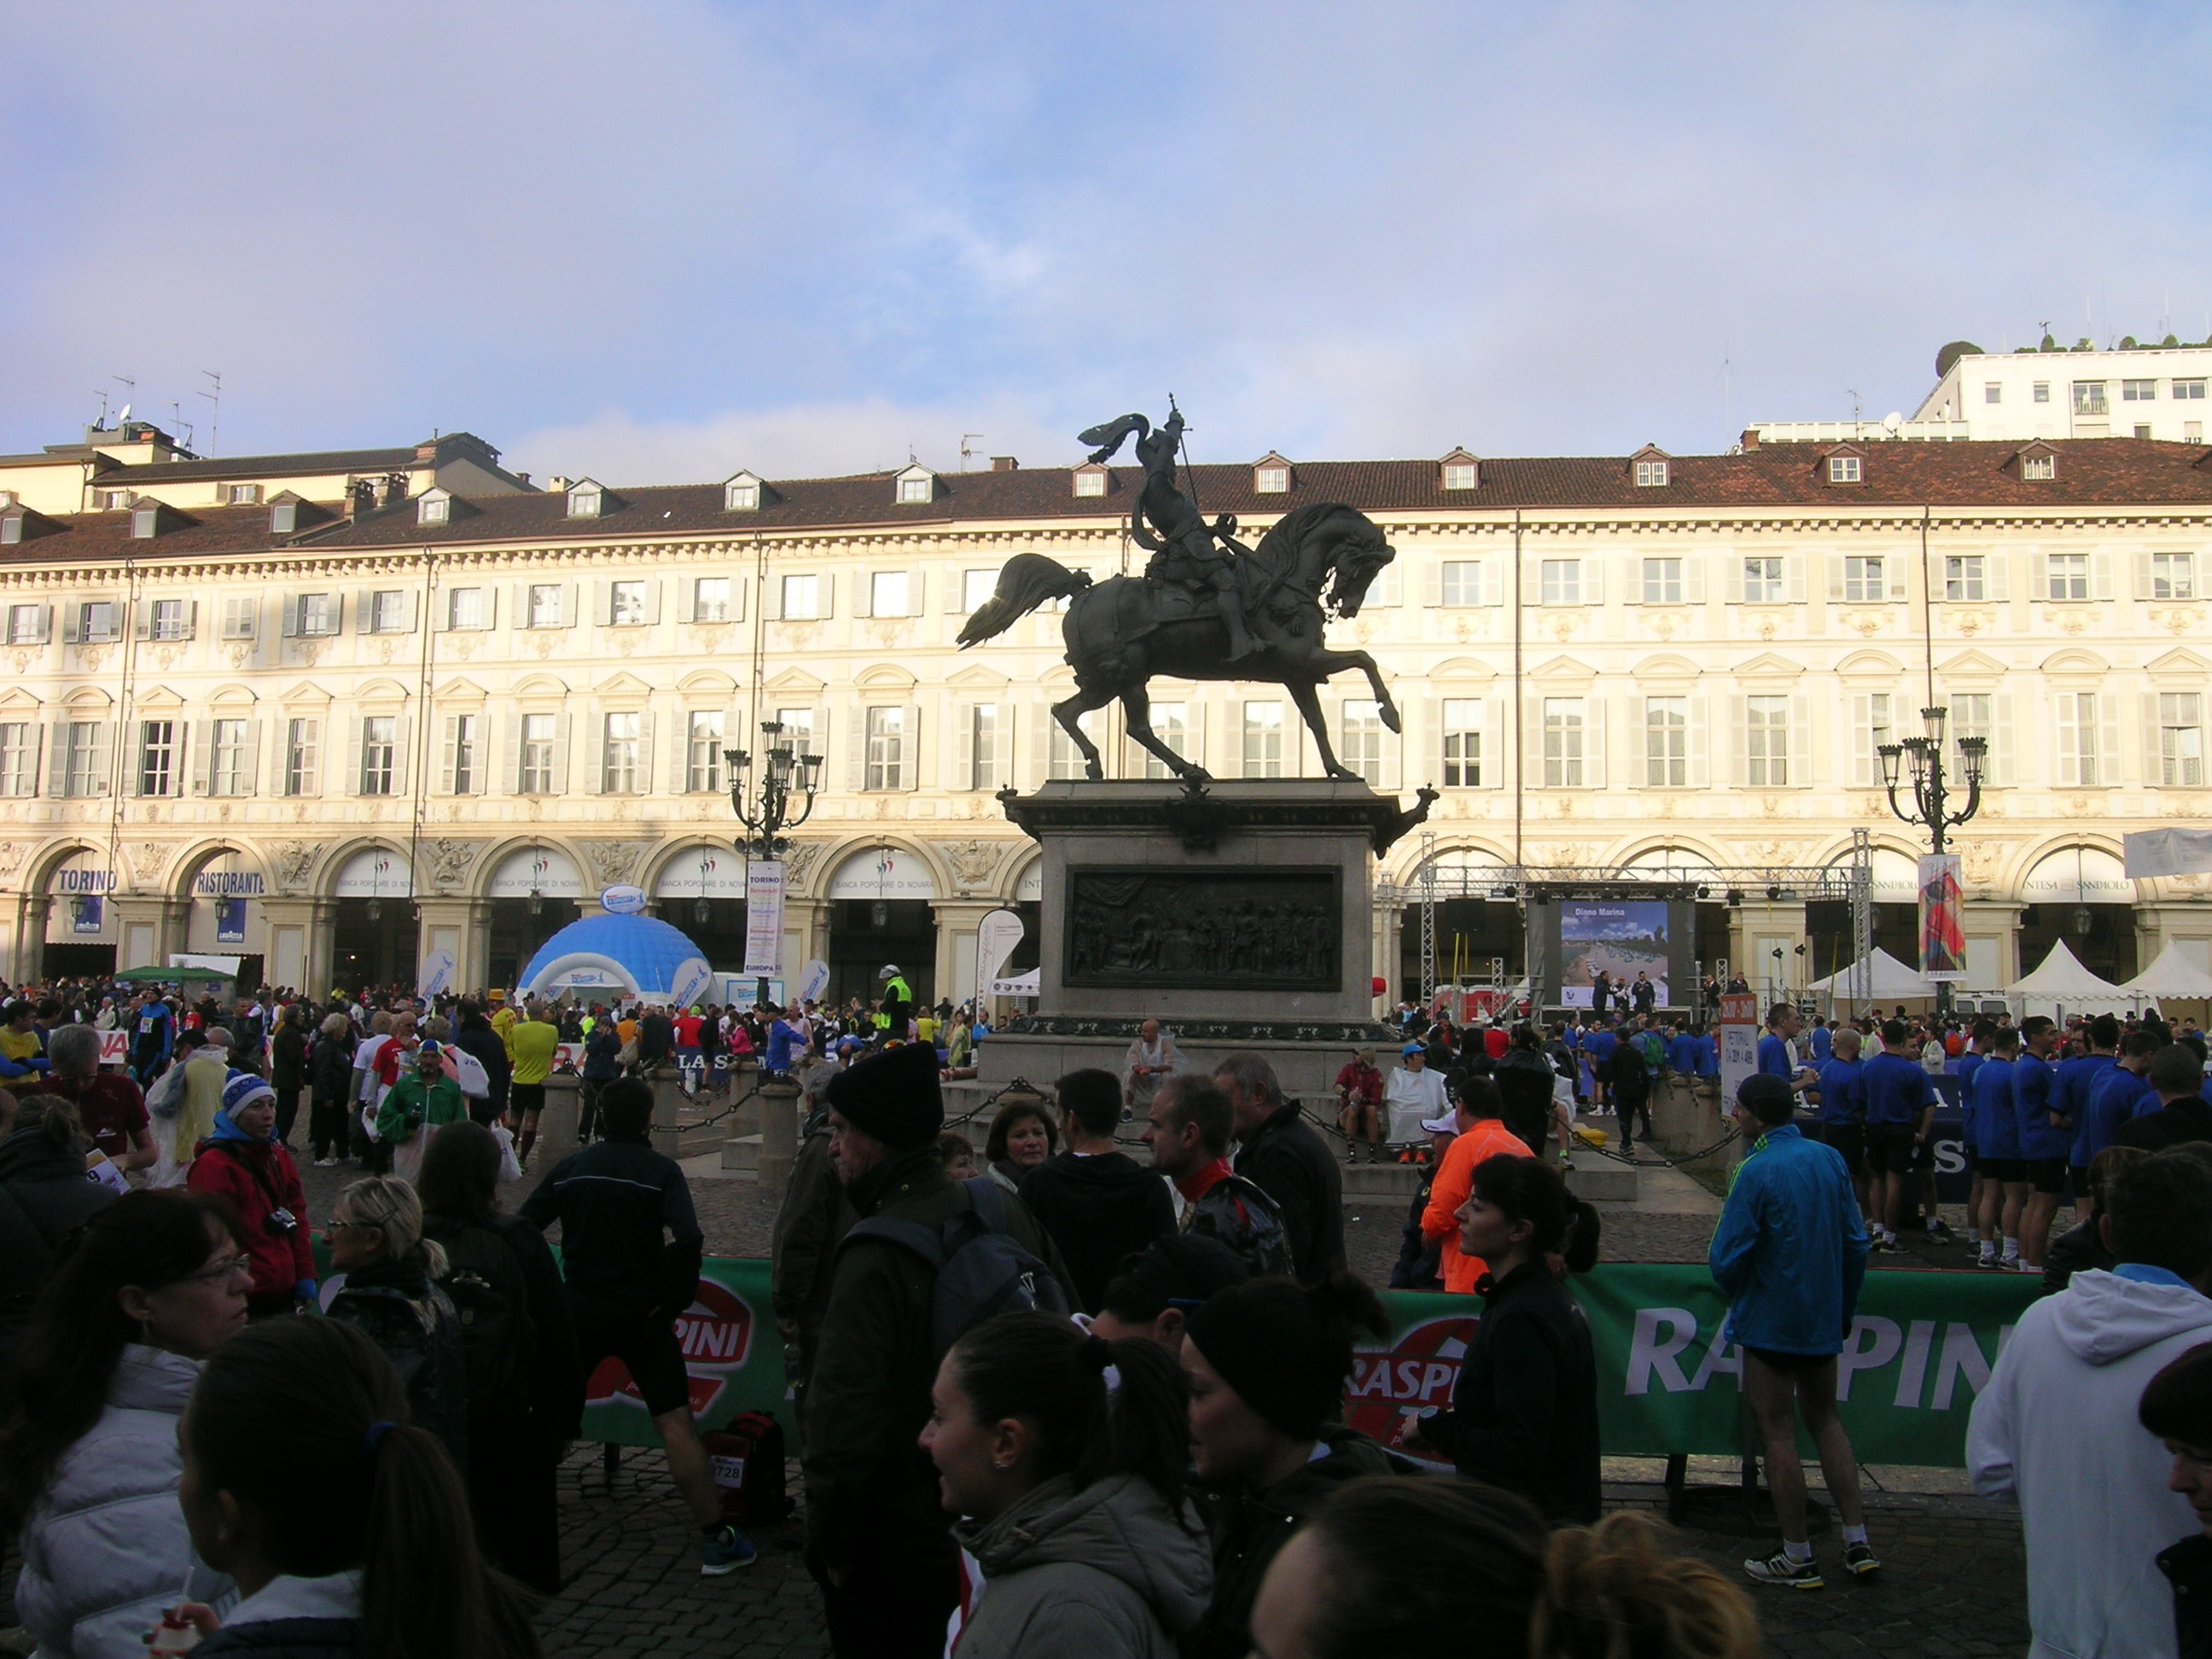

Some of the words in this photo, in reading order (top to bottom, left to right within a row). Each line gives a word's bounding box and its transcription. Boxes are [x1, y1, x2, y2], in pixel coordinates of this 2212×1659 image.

[60, 870, 117, 891] TORINO
[197, 872, 264, 894] RISTORANTE
[1024, 880, 1041, 888] INT
[1343, 1359, 1461, 1404] RASPI
